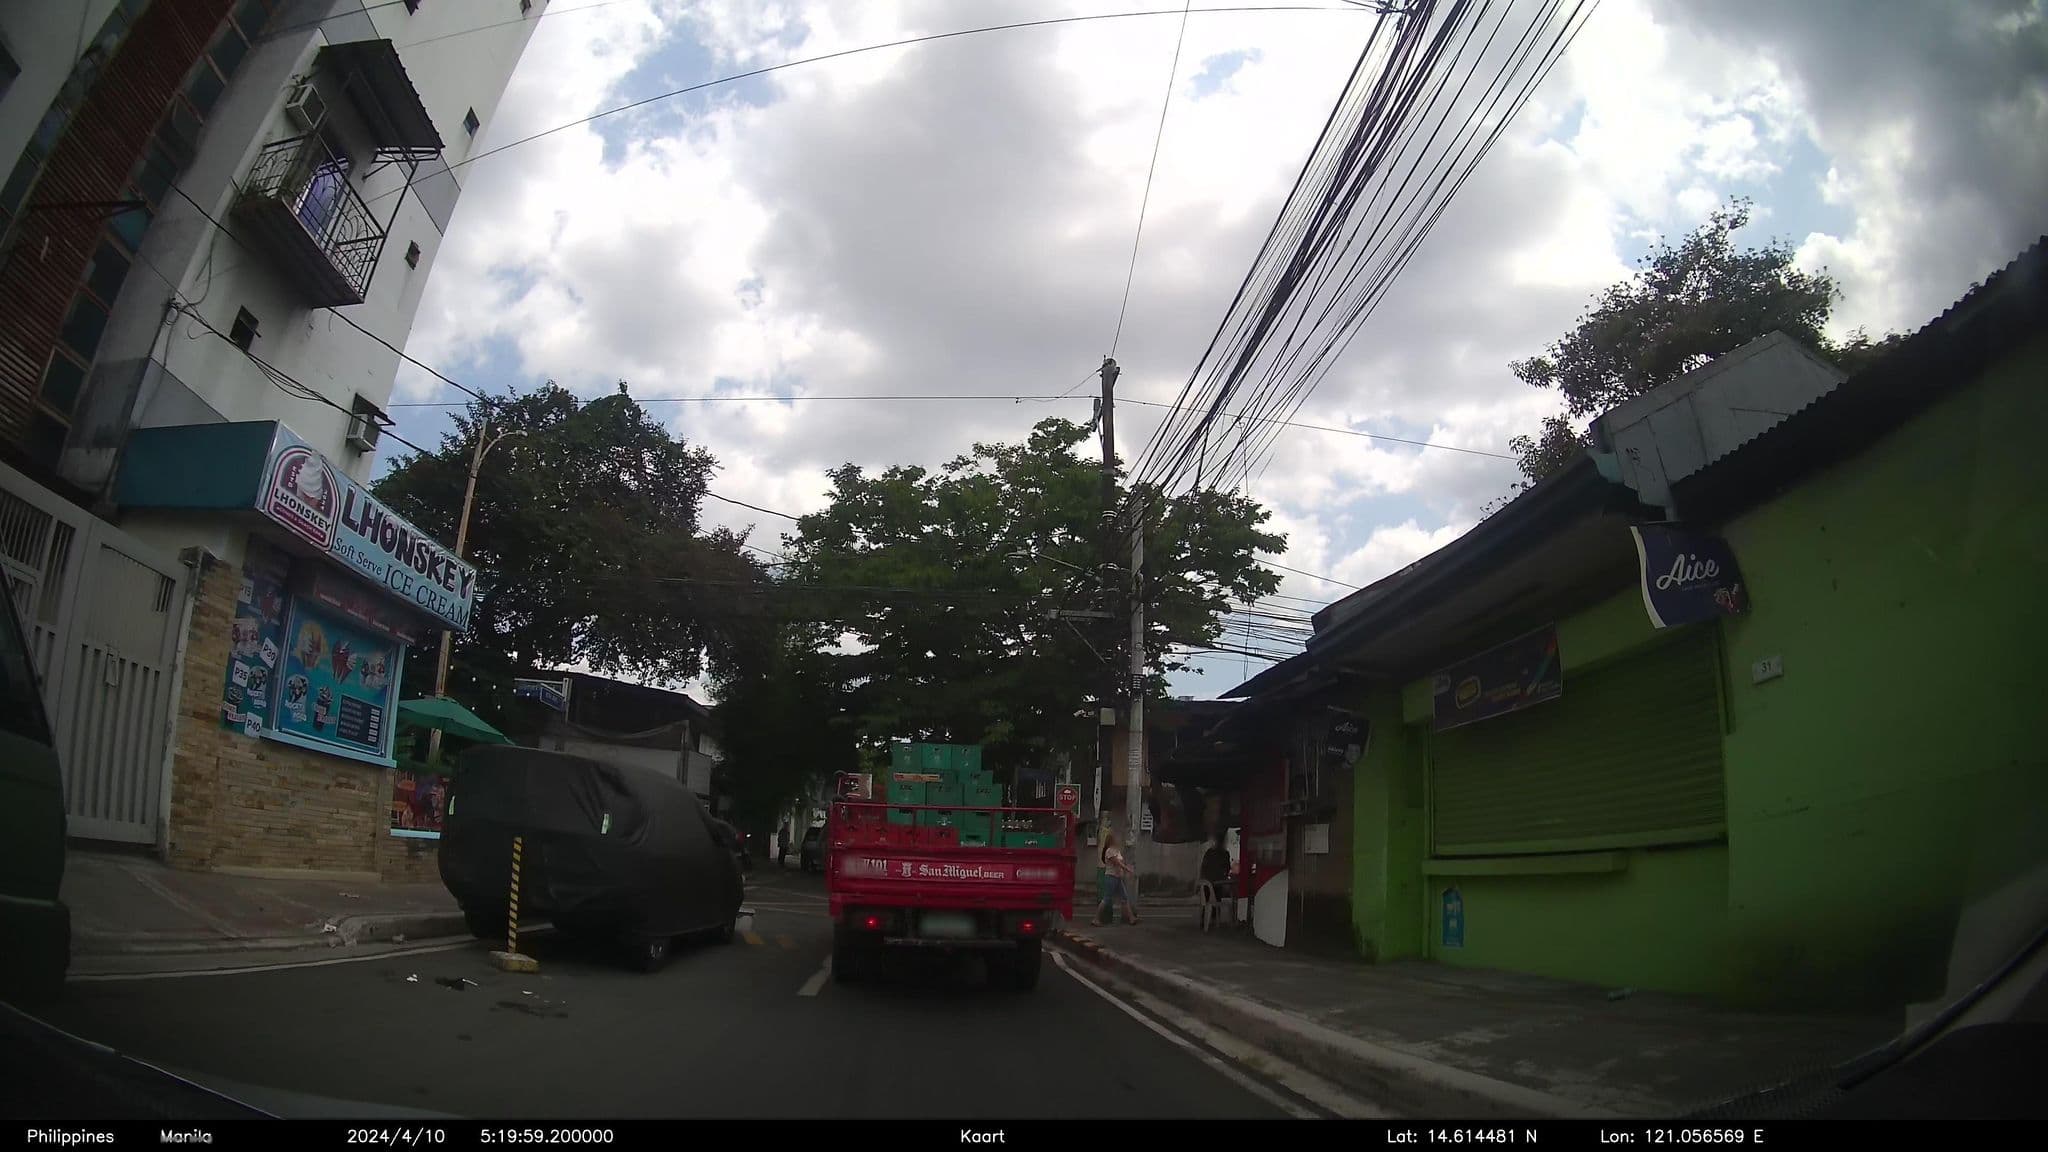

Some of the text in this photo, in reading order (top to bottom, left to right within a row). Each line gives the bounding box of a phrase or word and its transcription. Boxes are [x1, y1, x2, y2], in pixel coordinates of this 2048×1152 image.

[274, 487, 331, 532] LHONSKEY
[341, 484, 475, 600] LHONSKEY
[1656, 553, 1720, 590] Aice
[334, 538, 355, 561] Soft
[356, 551, 382, 575] Serve
[383, 564, 414, 597] ICE
[416, 585, 470, 628] CREAM
[262, 643, 277, 661] P30
[235, 667, 249, 681] P35
[1761, 661, 1772, 673] 31
[247, 719, 261, 734] P40
[1058, 793, 1077, 802] STOP
[919, 864, 942, 877] San
[942, 864, 982, 879] Miguel
